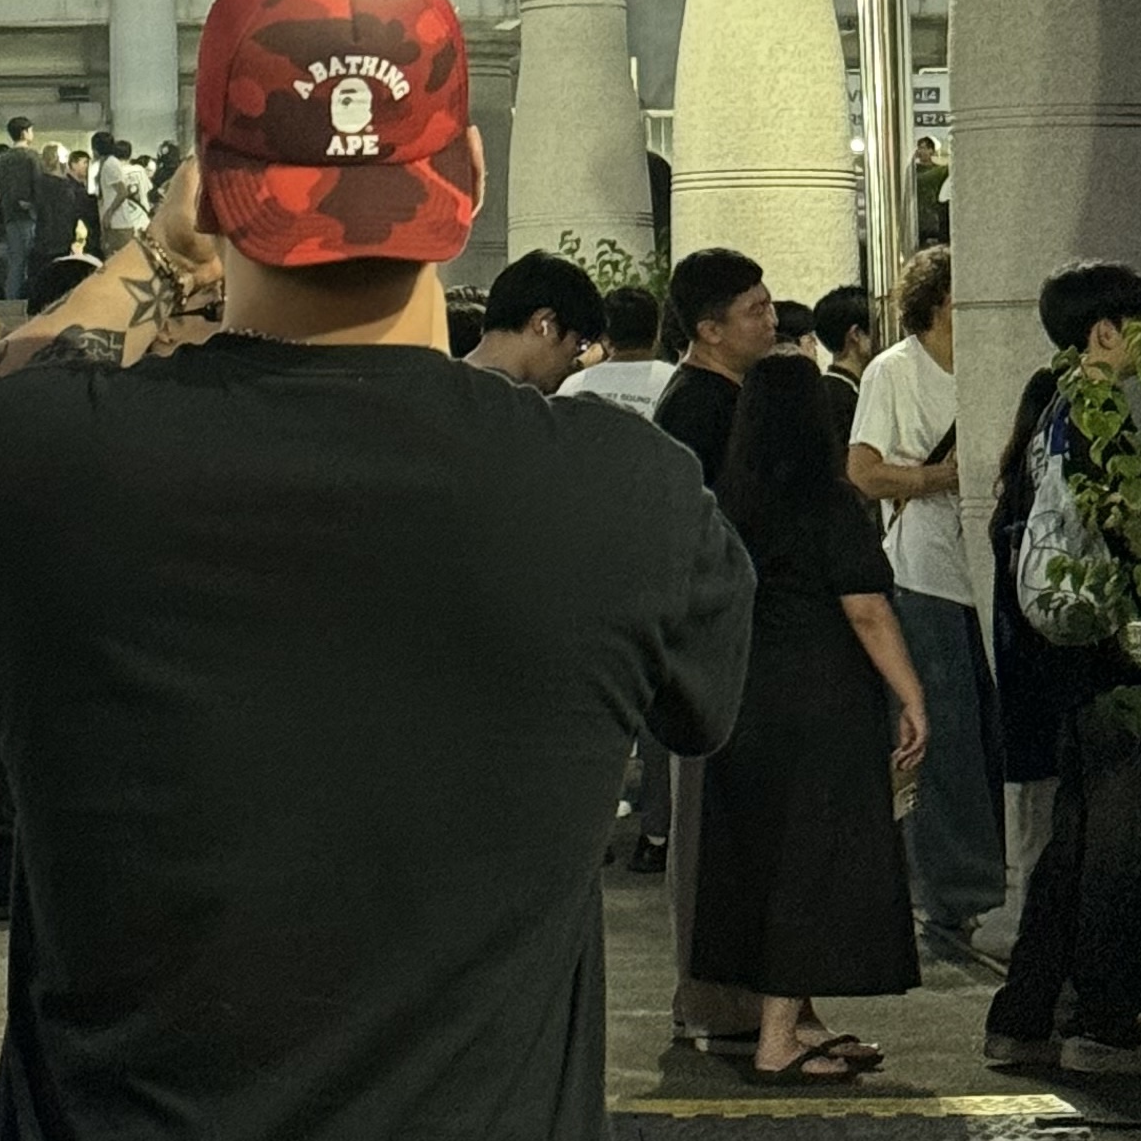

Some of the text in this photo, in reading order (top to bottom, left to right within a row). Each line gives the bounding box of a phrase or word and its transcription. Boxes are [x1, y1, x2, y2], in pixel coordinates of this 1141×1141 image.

[293, 55, 411, 101] A BATHING
[326, 135, 379, 155] APE
